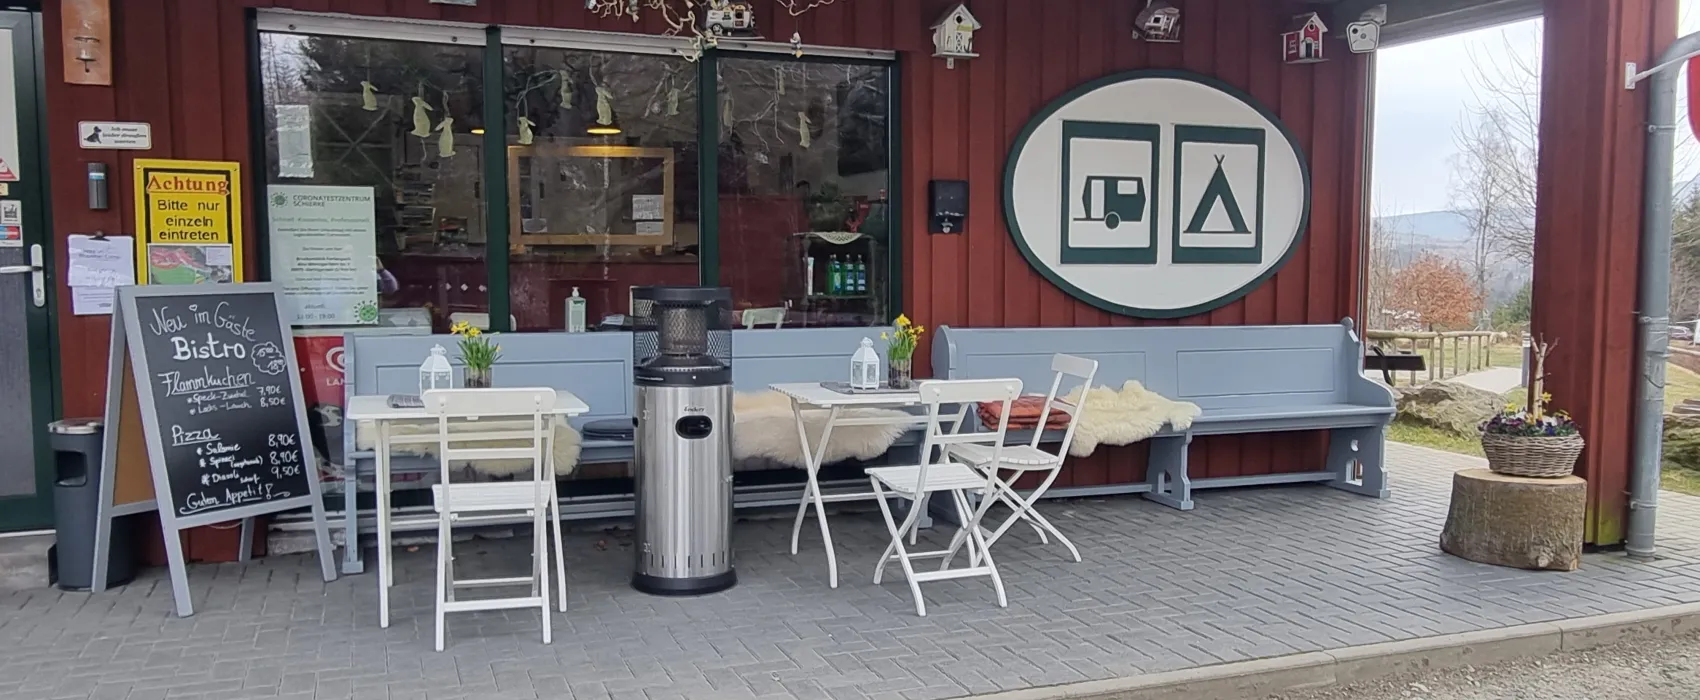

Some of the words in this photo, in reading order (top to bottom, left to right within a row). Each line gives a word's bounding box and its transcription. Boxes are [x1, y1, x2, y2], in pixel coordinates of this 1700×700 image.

[147, 174, 228, 196] Achtung
[157, 199, 188, 211] Bitte
[197, 201, 220, 212] nur
[165, 214, 213, 228] einzeln
[158, 229, 219, 241] eintreten
[150, 306, 187, 336] Neu
[192, 306, 211, 324] im
[213, 301, 256, 342] Gäste
[170, 332, 246, 361] Bistro
[157, 365, 256, 397] Flammkuchen
[255, 385, 282, 397] 7,90€
[259, 397, 287, 409] 8,50€
[171, 424, 221, 445] Pizza
[267, 434, 296, 448] 8,90€
[269, 450, 299, 465] 8,90€
[270, 465, 301, 480] 9,50€
